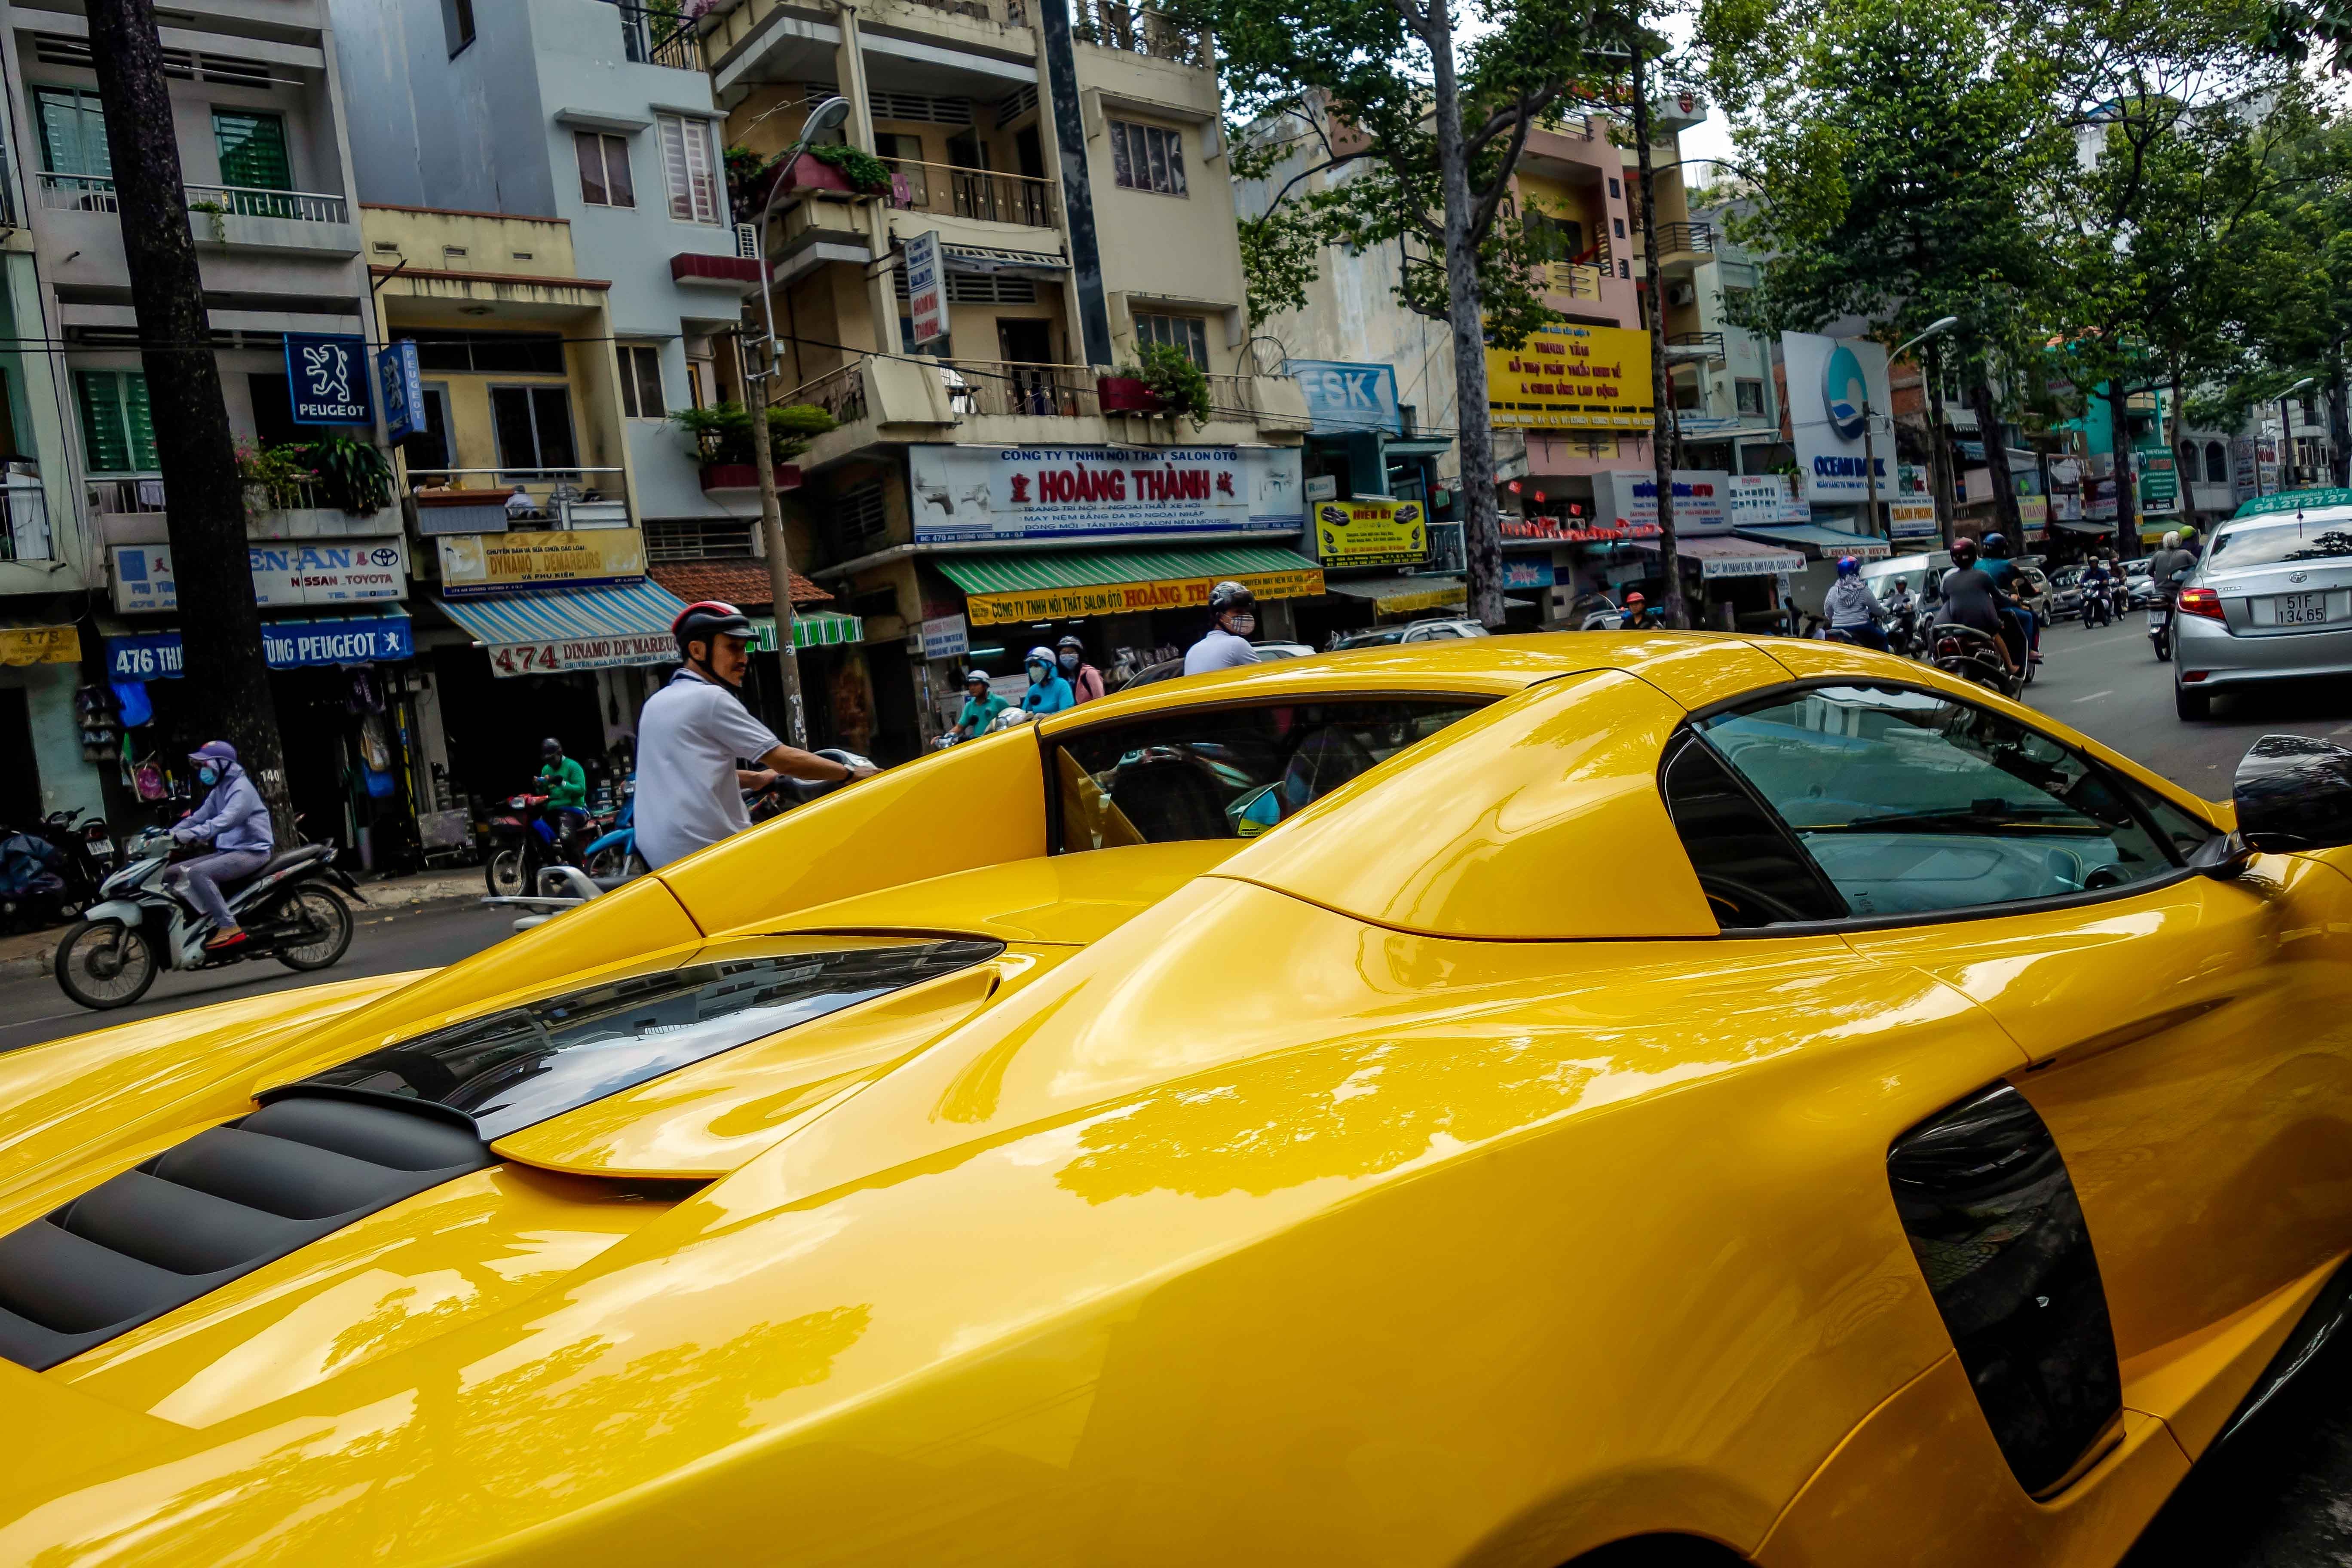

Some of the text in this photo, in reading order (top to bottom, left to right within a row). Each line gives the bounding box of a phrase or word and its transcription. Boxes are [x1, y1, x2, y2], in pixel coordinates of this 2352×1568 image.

[1535, 340, 1589, 356] TRUNG TÂM
[406, 349, 420, 420] PEUGEOT
[300, 403, 365, 416] PEUGEOT
[1044, 450, 1062, 460] TY
[1066, 450, 1105, 461] TNHH
[1170, 450, 1210, 461] SALON
[1814, 455, 1887, 477] OCEAN BAK
[1038, 461, 1210, 503] HOÀNG THÀNH
[2304, 496, 2324, 505] 27
[2327, 493, 2348, 503] 27
[1892, 505, 1933, 521] THÀNH PHONG
[932, 533, 946, 542] 470
[490, 550, 601, 575] DYNAMO DEMAREURS
[291, 573, 393, 588] NISSAN TOYOTA
[991, 598, 1013, 618] CÔNG
[1014, 600, 1025, 616] TY
[1026, 598, 1047, 615] TNHH
[1048, 593, 1062, 616] NỘI
[1063, 590, 1083, 611] THẤT
[1084, 594, 1106, 610] SALON
[1107, 589, 1123, 608] ÔTÔ
[1124, 583, 1183, 607] HOÀNG
[2287, 595, 2313, 609] 51F
[2279, 607, 2324, 623] 134.65
[116, 647, 154, 674] 476
[263, 634, 294, 663] ÙNG
[297, 632, 376, 661] PEUGEOT
[495, 645, 560, 672] 474
[613, 636, 679, 656] DE'MAREU
